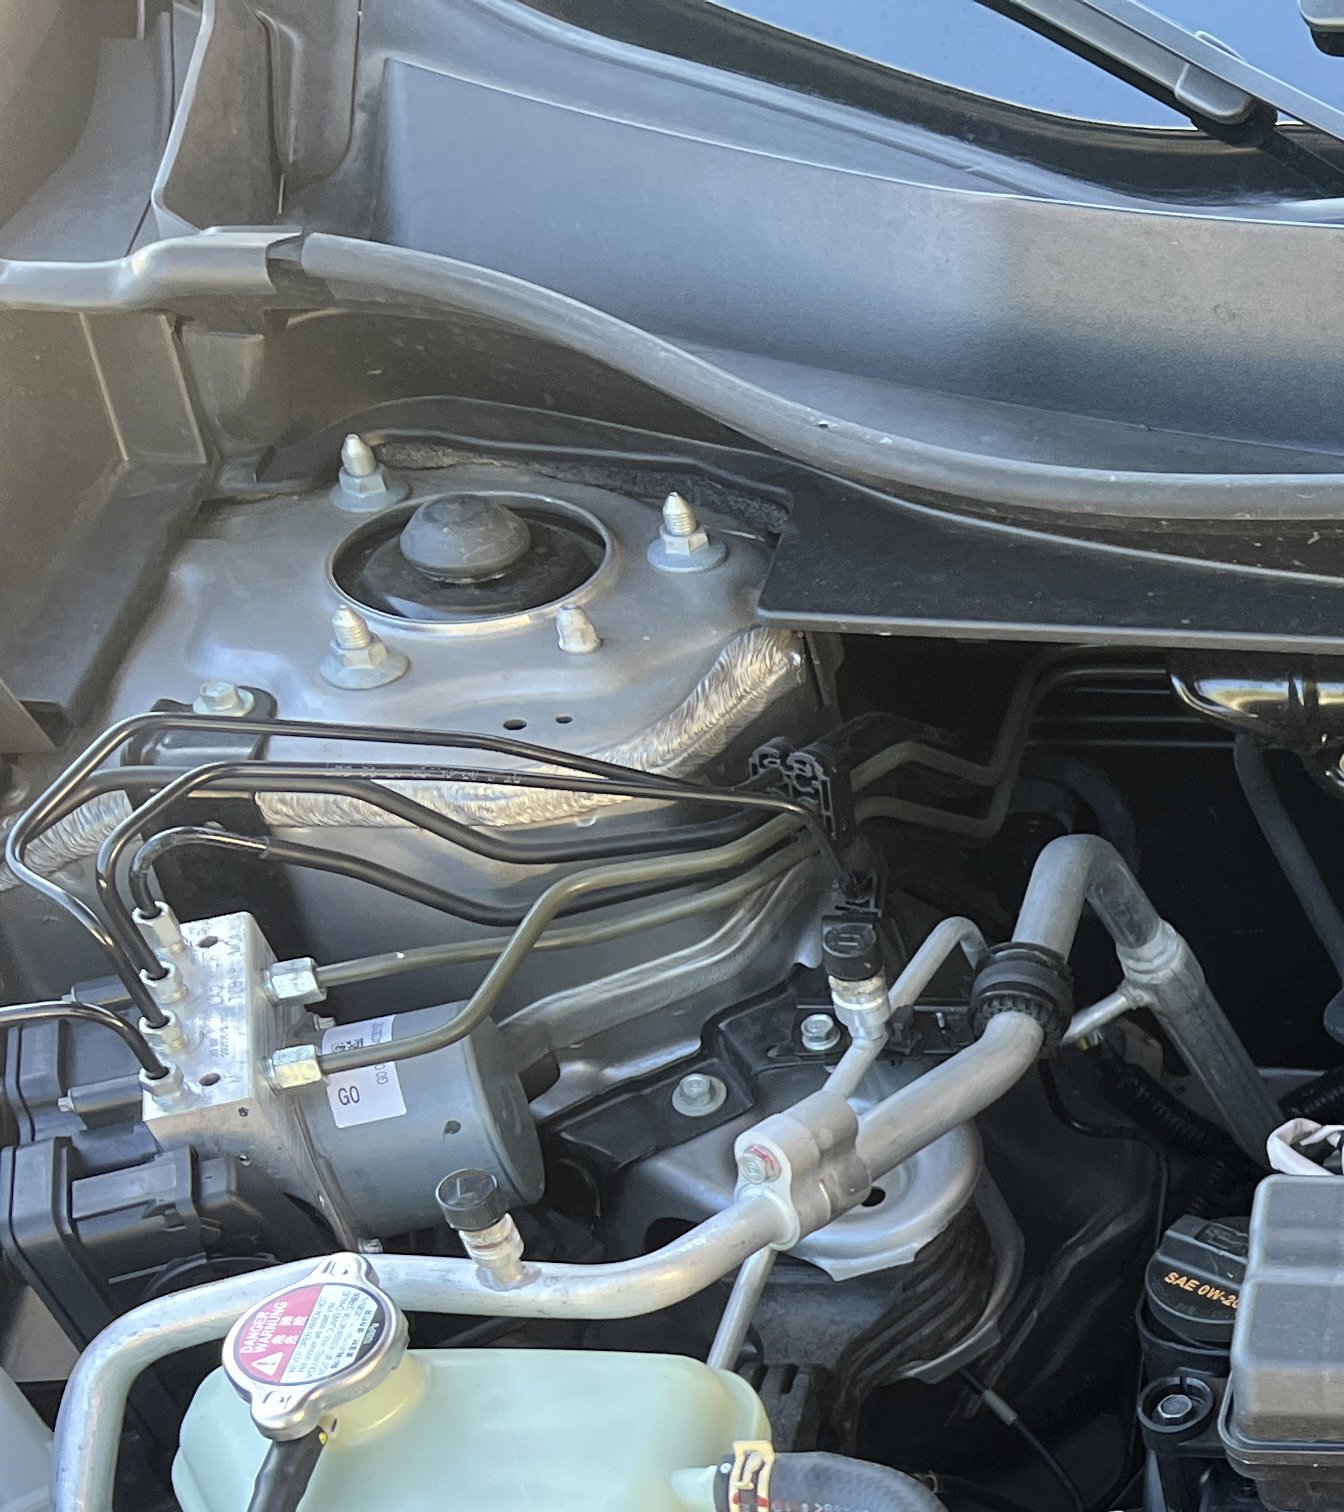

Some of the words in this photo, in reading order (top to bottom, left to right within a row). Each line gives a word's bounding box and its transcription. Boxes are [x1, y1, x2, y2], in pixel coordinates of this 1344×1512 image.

[1165, 1271, 1202, 1292] SAE
[239, 1311, 268, 1355] DANGER
[253, 1301, 289, 1352] WARNUNG
